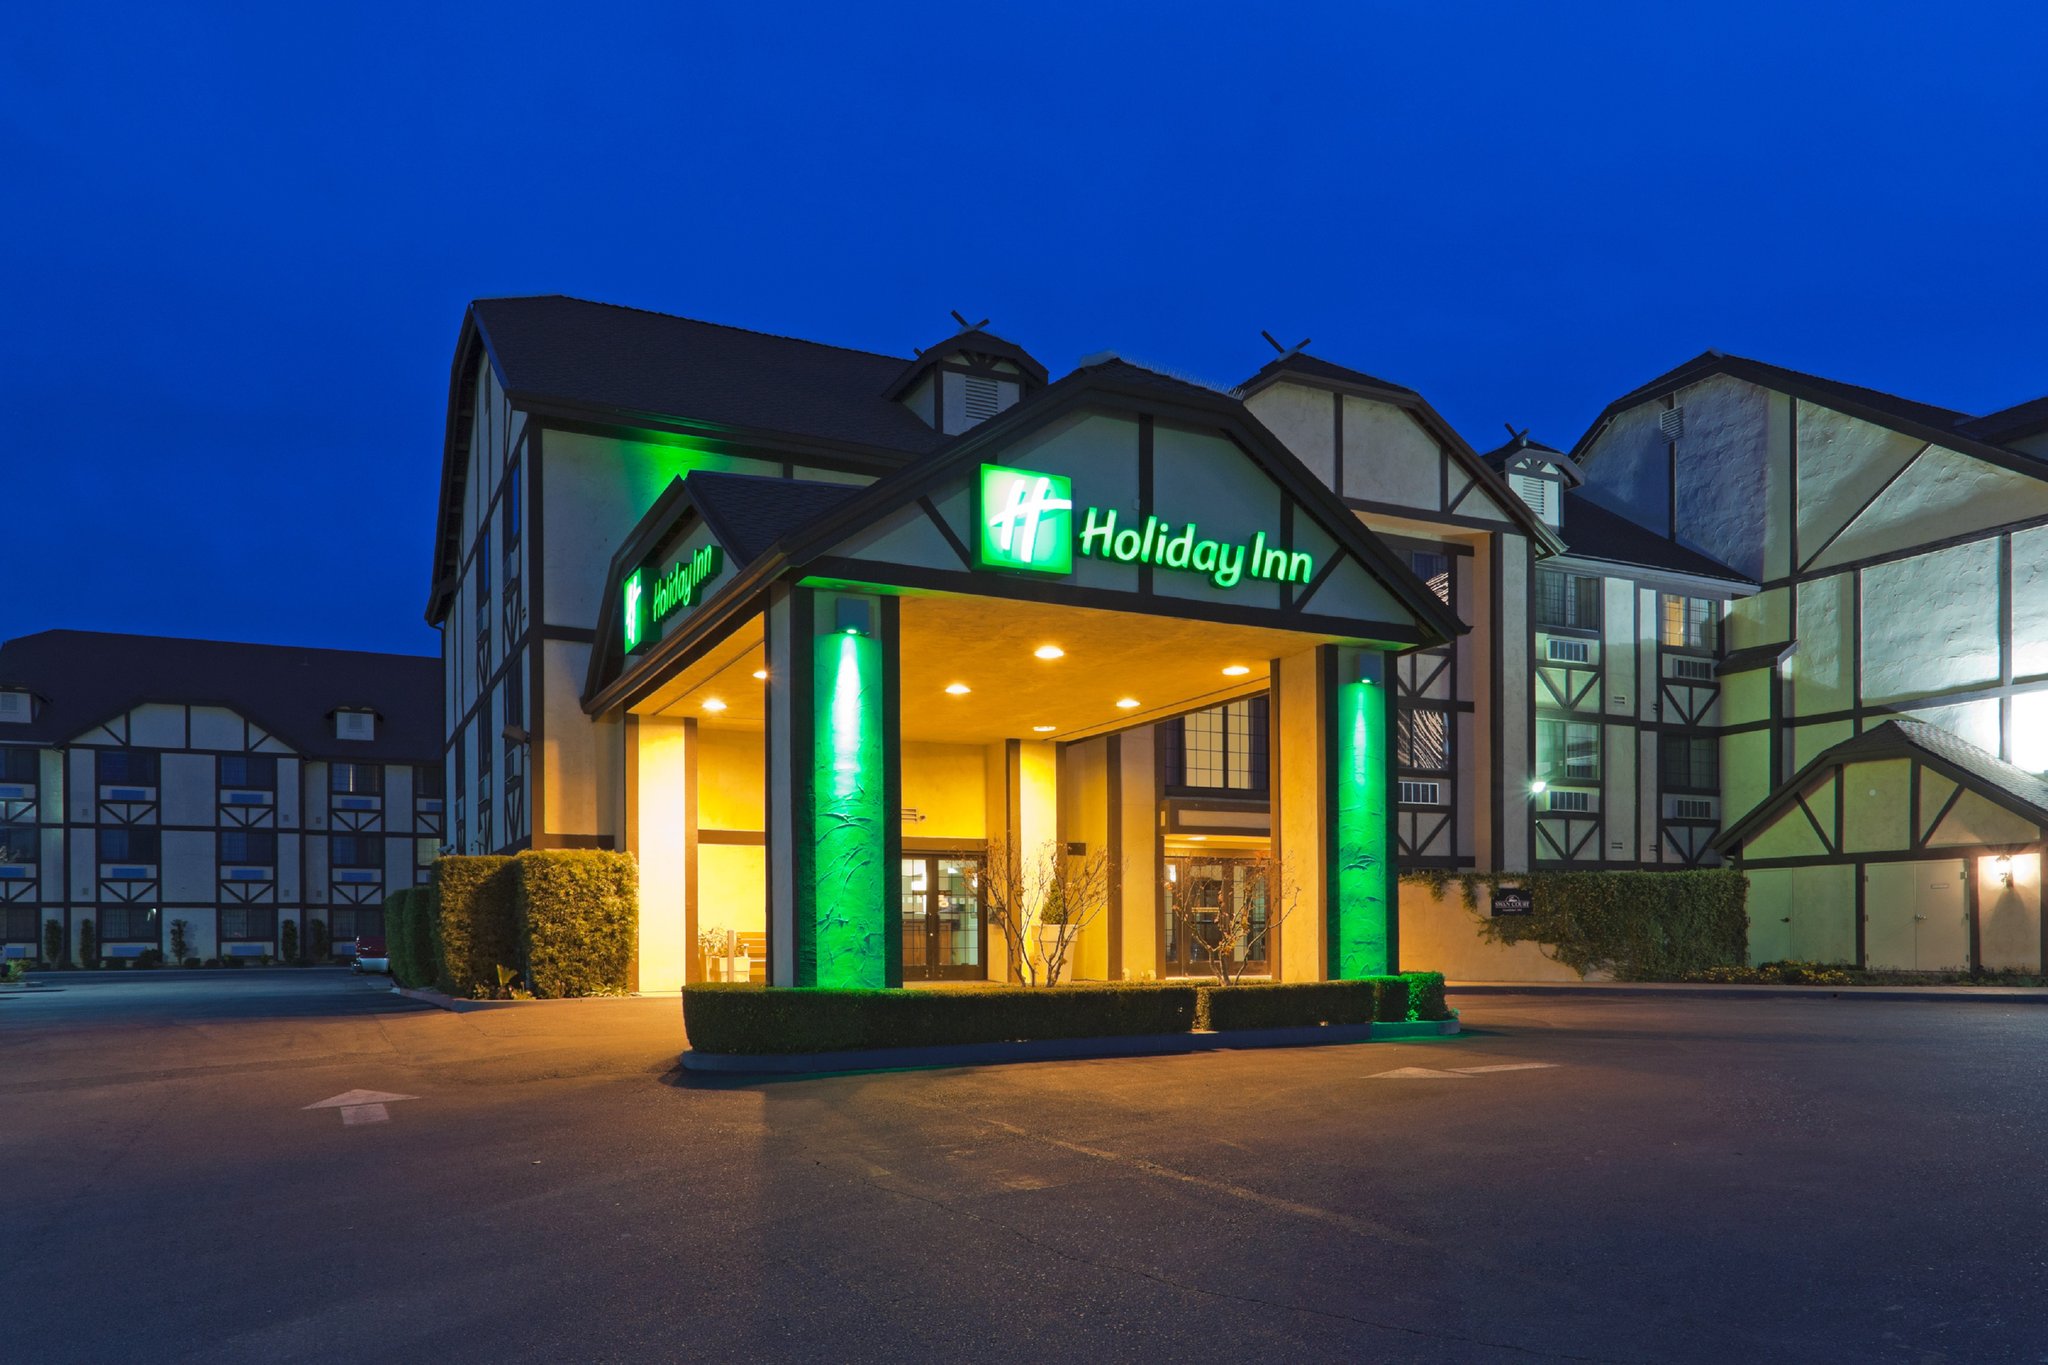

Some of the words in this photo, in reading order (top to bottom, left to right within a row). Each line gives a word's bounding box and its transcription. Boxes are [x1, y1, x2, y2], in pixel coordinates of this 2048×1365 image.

[653, 562, 693, 622] Holiday
[693, 544, 712, 587] Inn
[1079, 507, 1245, 587] Holiday
[1250, 531, 1313, 584] Inn
